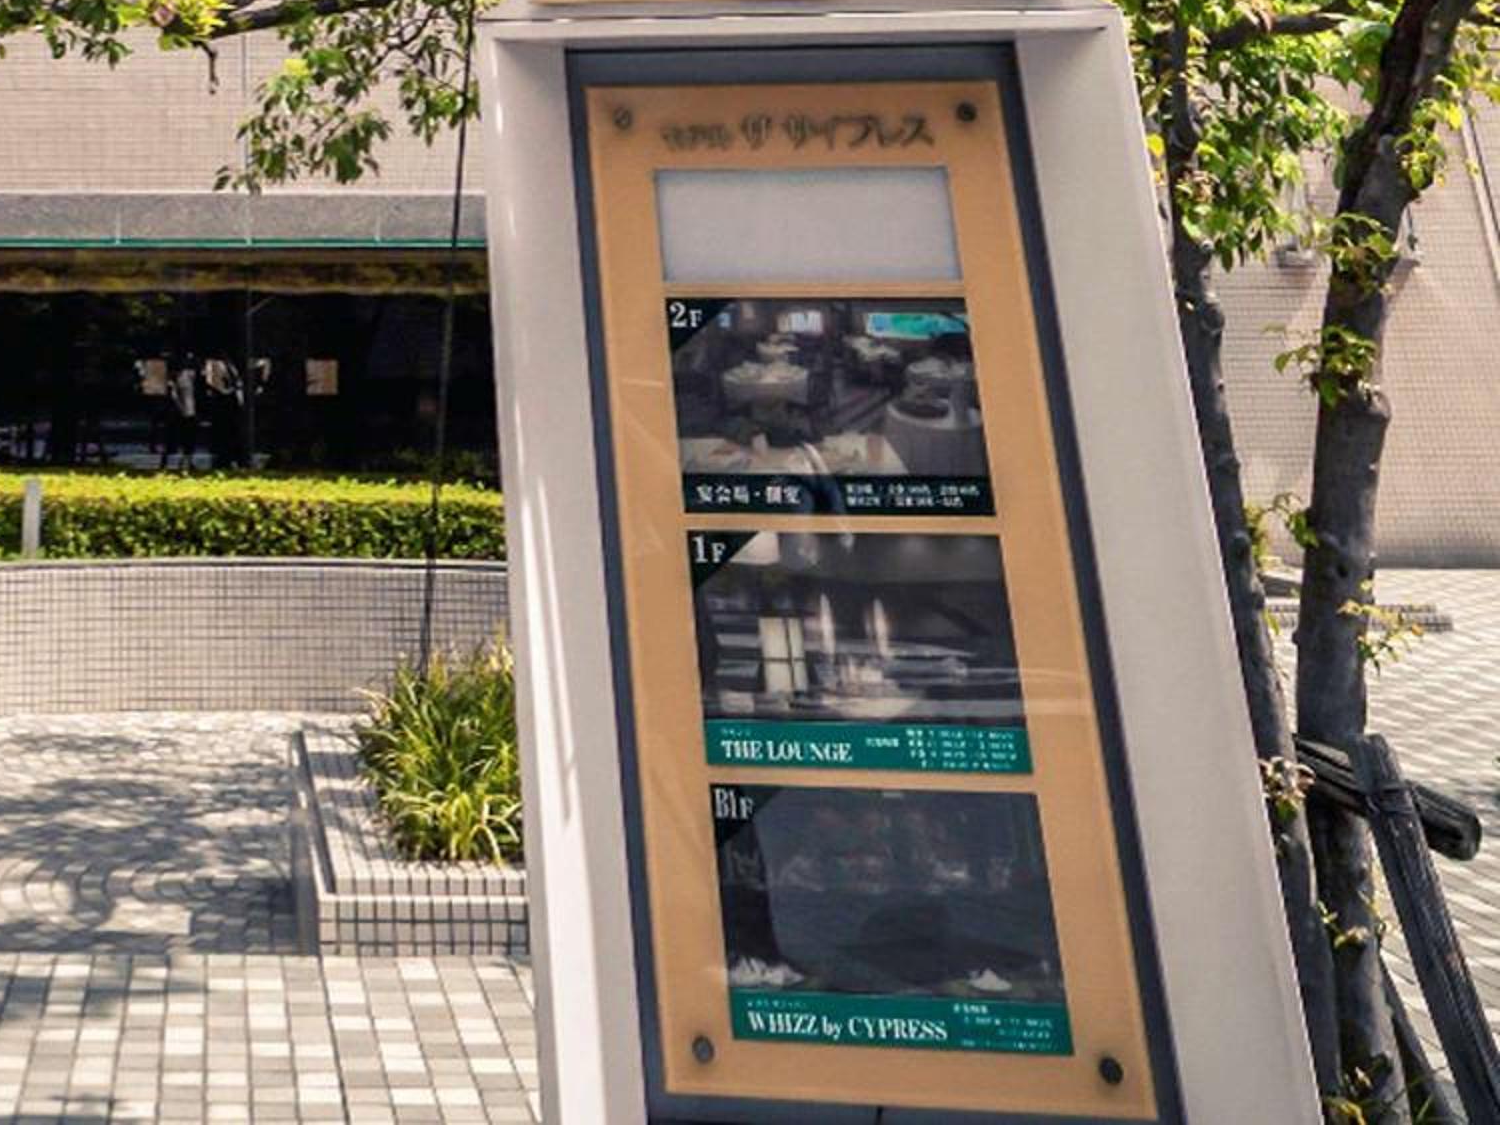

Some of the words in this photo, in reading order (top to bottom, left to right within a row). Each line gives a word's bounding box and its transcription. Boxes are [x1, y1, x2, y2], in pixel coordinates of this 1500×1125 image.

[669, 302, 702, 328] 2F
[692, 535, 726, 563] 1F
[721, 739, 763, 760] THE
[767, 740, 853, 763] LOUNGE
[713, 787, 754, 820] B1F
[747, 1011, 819, 1035] WHIZZ
[822, 1015, 842, 1041] by
[848, 1016, 948, 1041] CYPRESS
